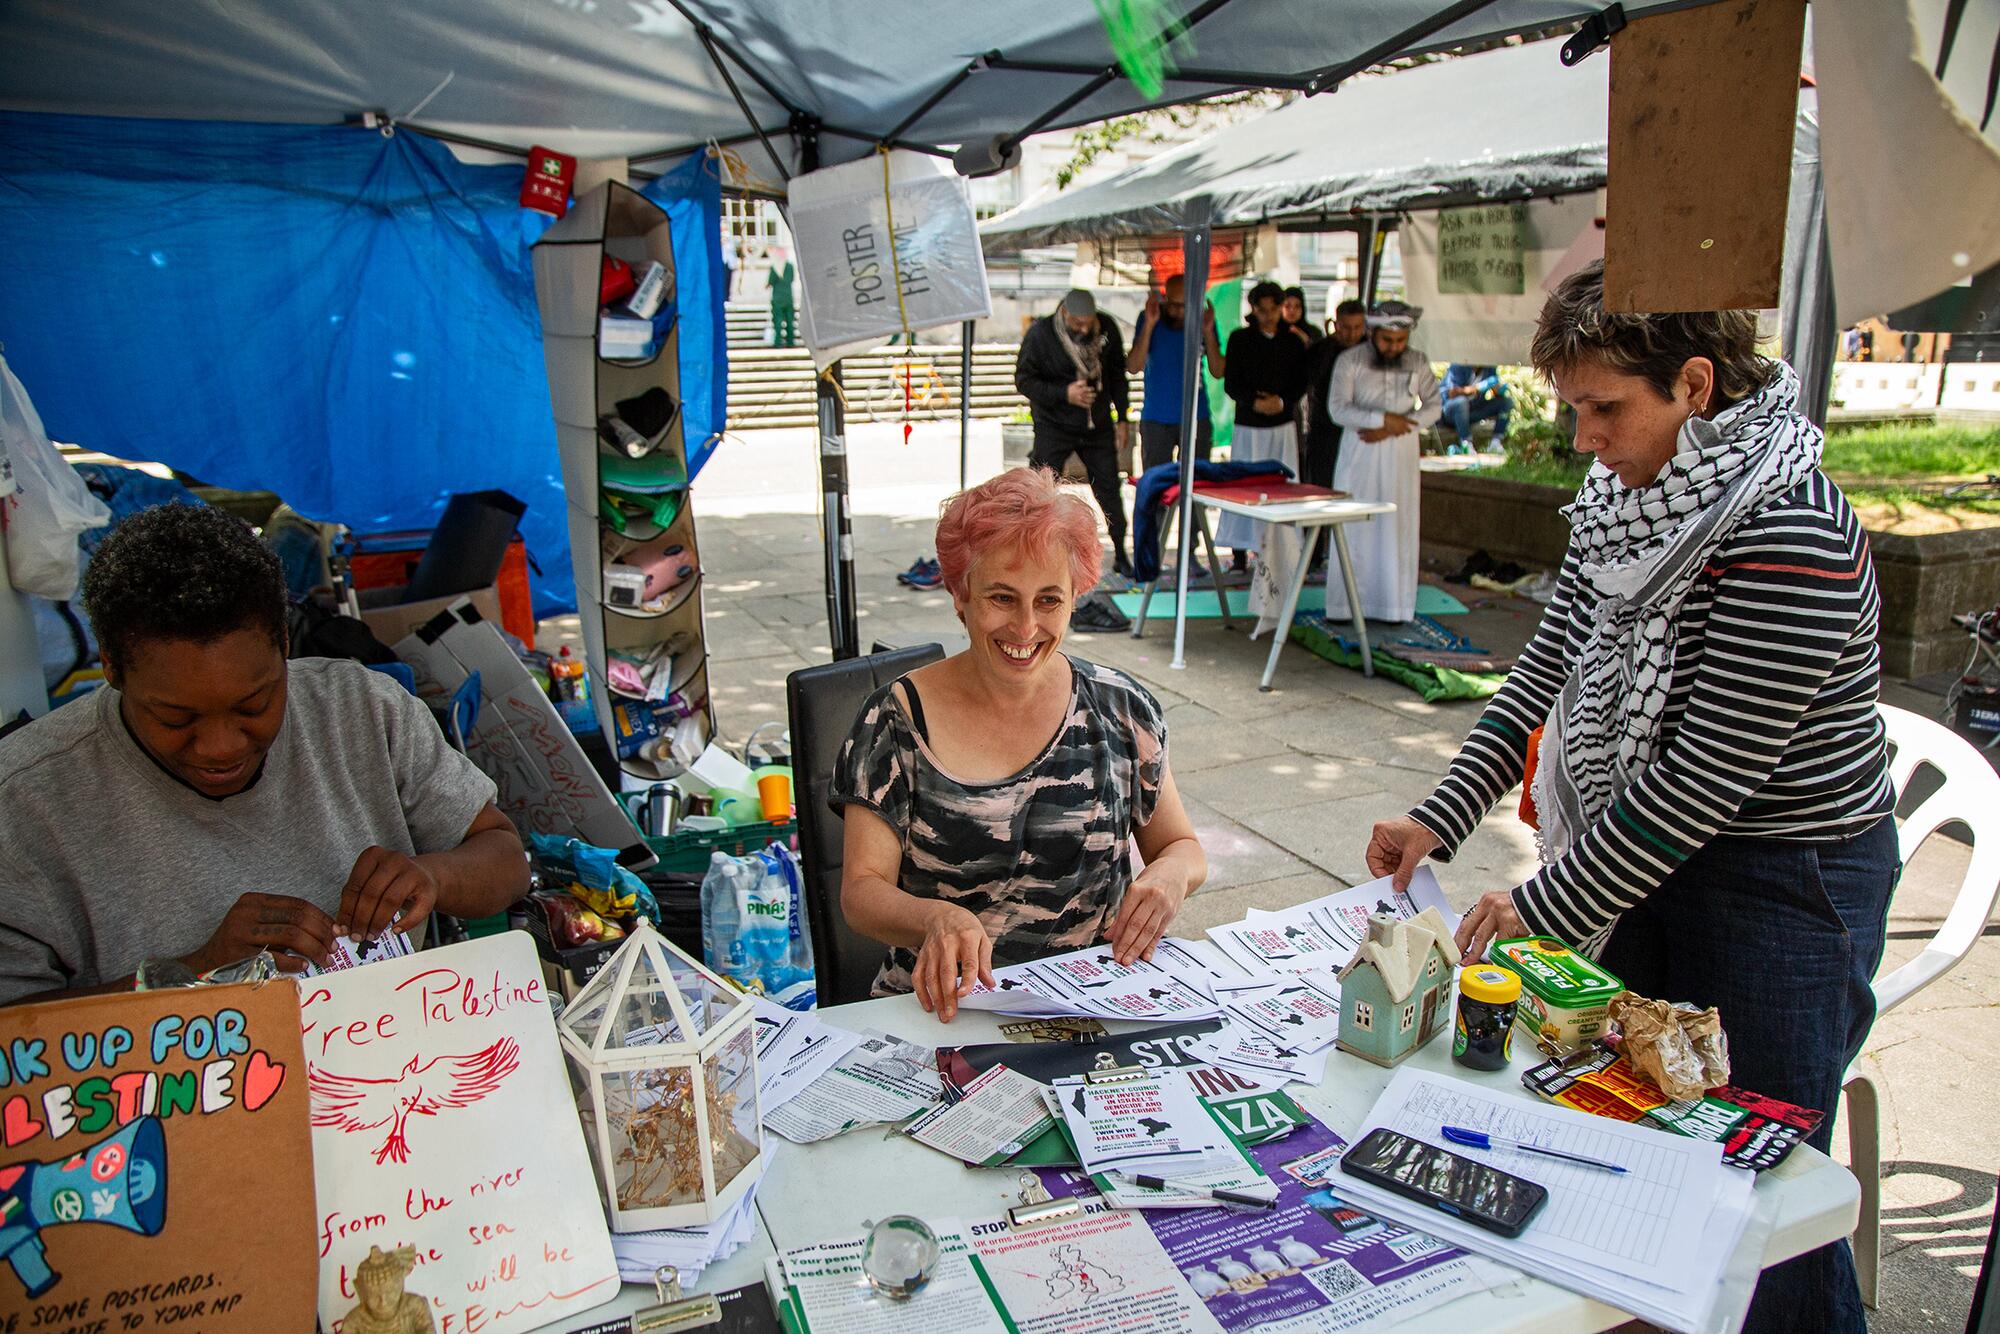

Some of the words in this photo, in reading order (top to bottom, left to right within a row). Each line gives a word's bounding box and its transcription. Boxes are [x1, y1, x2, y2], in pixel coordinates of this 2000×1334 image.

[843, 224, 885, 306] POSTER
[890, 216, 930, 297] FRAME
[1523, 953, 1574, 989] FLORA
[395, 968, 545, 1027] Palestine
[62, 1026, 134, 1072] UP
[150, 1008, 251, 1064] FOR
[1129, 1035, 1215, 1068] STO
[834, 1065, 876, 1086] campaign
[875, 1081, 891, 1092] the
[1088, 1087, 1126, 1095] HACKNEY
[2, 1058, 237, 1148] LESTINE
[892, 1088, 912, 1101] Join
[1104, 1103, 1144, 1111] GENOCIDE
[1096, 1133, 1137, 1141] PALESTINE
[1673, 1101, 1743, 1142] ISRAEL
[320, 1211, 386, 1257] from
[405, 1188, 453, 1220] the
[469, 1167, 525, 1199] river
[971, 1222, 1008, 1236] STOP
[1172, 1240, 1197, 1251] survey
[1198, 1232, 1218, 1244] below
[1246, 1217, 1266, 1227] know
[1281, 1207, 1299, 1216] views
[468, 1222, 515, 1246] sea
[981, 1248, 997, 1256] the
[998, 1240, 1039, 1253] genocide
[1041, 1237, 1050, 1245] of
[1052, 1228, 1101, 1242] Palestinian
[1103, 1220, 1132, 1233] people
[989, 1236, 1012, 1245] arms
[1014, 1227, 1062, 1241] companies
[1064, 1222, 1078, 1230] are
[1080, 1214, 1120, 1228] complicit
[1194, 1235, 1236, 1252] investments
[1250, 1222, 1278, 1233] whether
[1288, 1213, 1305, 1221] need
[1231, 1234, 1261, 1248] increase
[1272, 1220, 1304, 1233] influence
[466, 1256, 521, 1293] will
[544, 1242, 575, 1263] be
[790, 1258, 822, 1266] Your
[824, 1253, 861, 1265] pensi
[790, 1270, 824, 1279] used
[826, 1268, 841, 1276] to
[30, 1298, 90, 1327] SOME
[102, 1273, 222, 1313] POSTCARDS.
[1330, 1300, 1357, 1313] WITH
[1379, 1287, 1392, 1296] TO
[1393, 1279, 1414, 1292] GET
[1416, 1261, 1466, 1281] INVOLVED
[121, 1312, 144, 1330] TO
[154, 1301, 205, 1325] YOUR
[210, 1294, 243, 1315] MP
[1334, 1292, 1401, 1322] ORGANISING
[602, 1321, 630, 1333] buying
